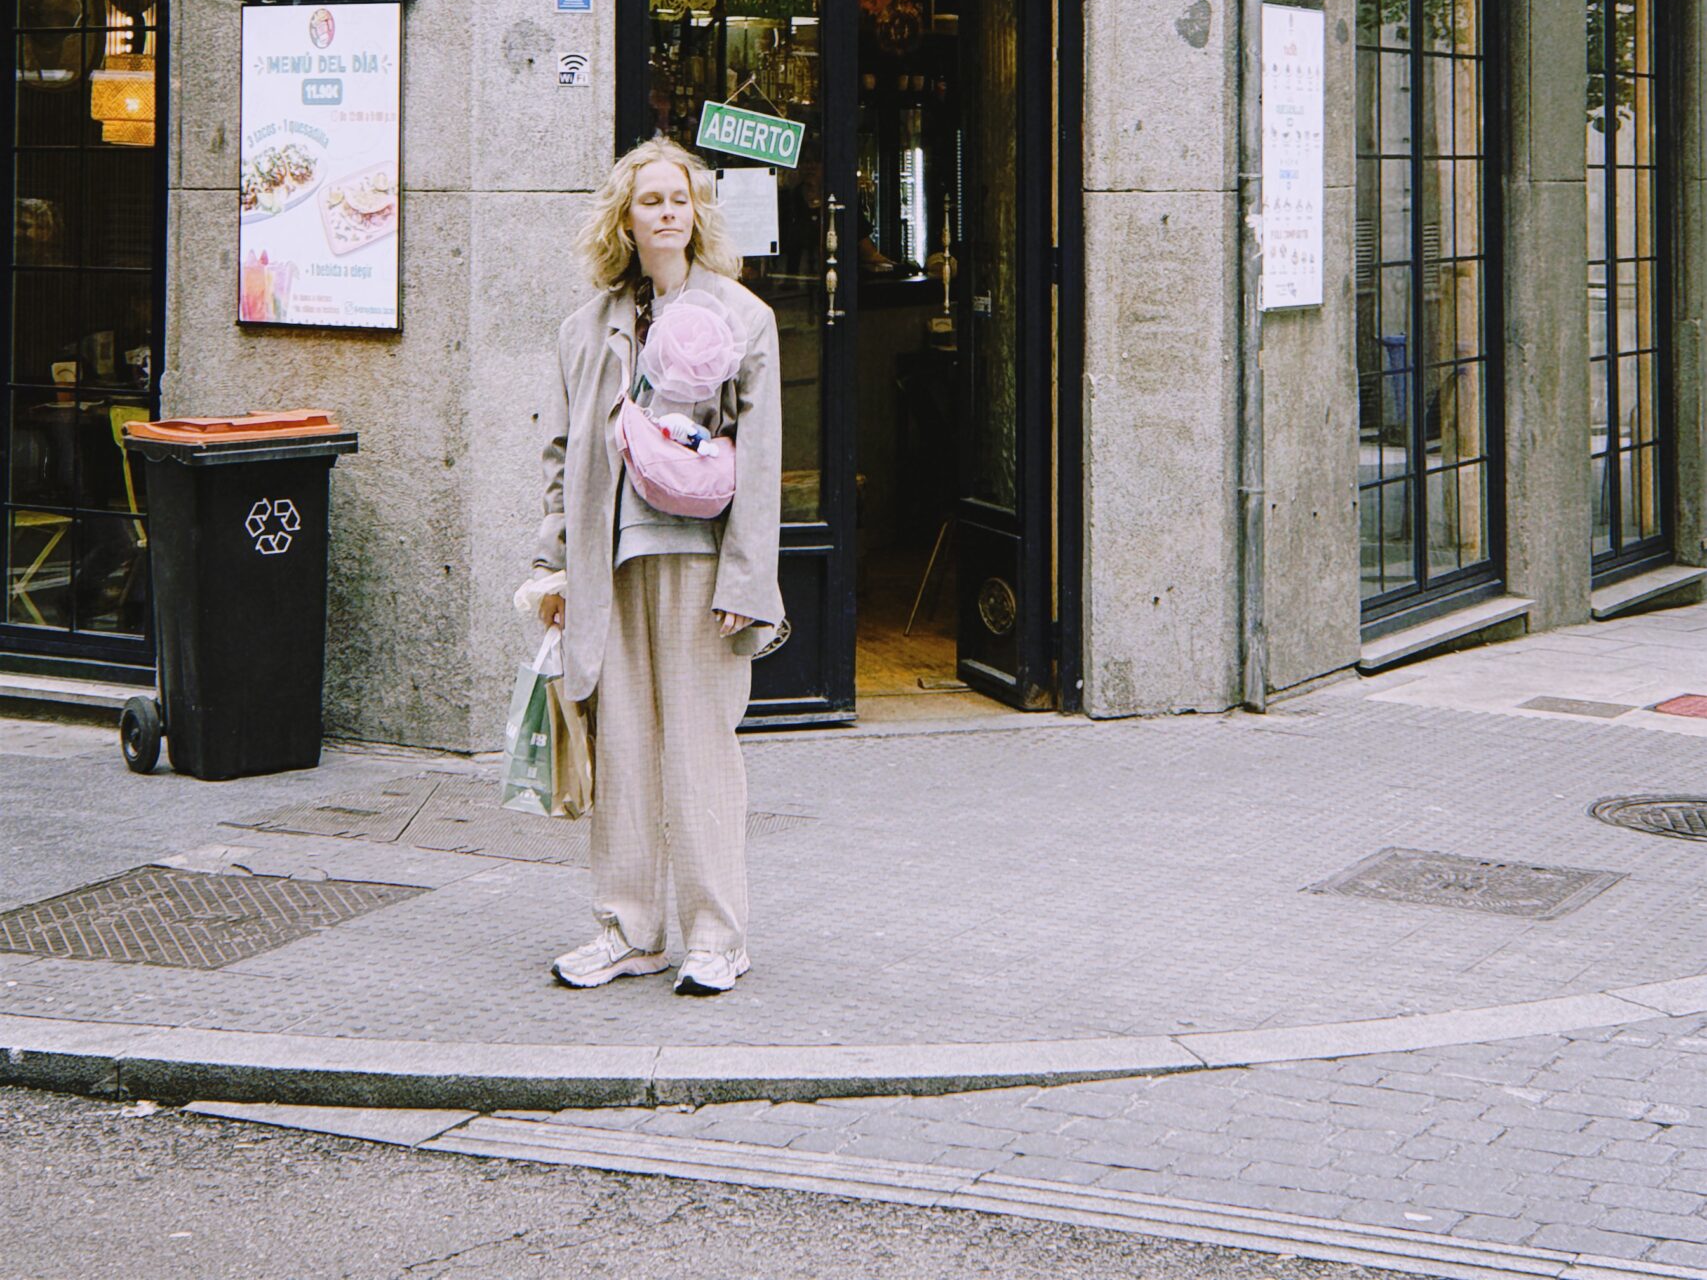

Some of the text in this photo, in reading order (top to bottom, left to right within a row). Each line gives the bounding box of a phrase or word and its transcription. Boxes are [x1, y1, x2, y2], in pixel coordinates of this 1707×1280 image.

[266, 51, 378, 73] MENÚ DEL DÍA
[253, 122, 276, 144] tacos
[289, 120, 329, 149] quesadilla
[704, 112, 795, 158] ABIERTO
[316, 263, 341, 277] bebida
[351, 264, 372, 279] elegir
